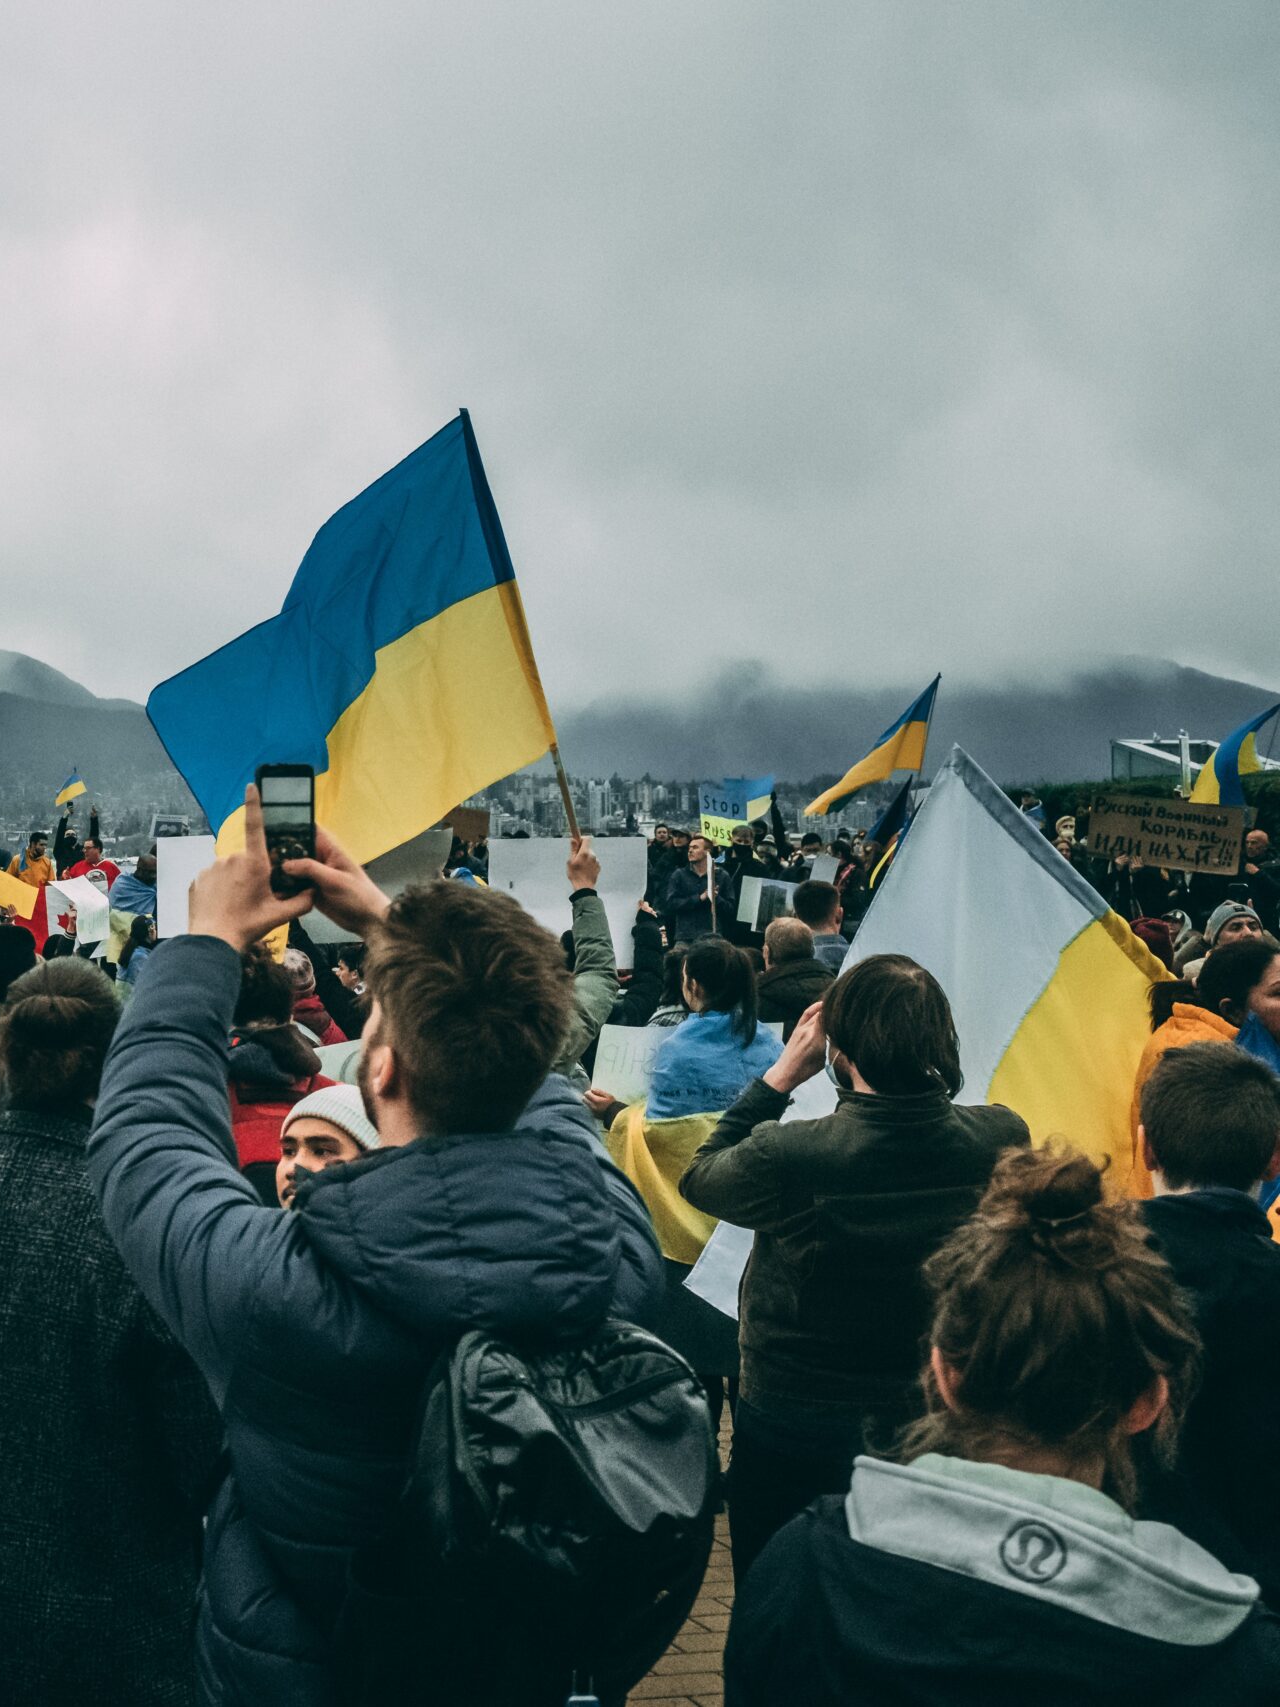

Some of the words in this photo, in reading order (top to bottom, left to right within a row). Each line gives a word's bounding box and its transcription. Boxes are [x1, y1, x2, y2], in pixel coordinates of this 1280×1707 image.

[704, 795, 740, 816] Stop
[704, 821, 732, 841] Russ
[1140, 819, 1221, 844] КОРАБЛЬ
[1094, 833, 1141, 857] ИДИ
